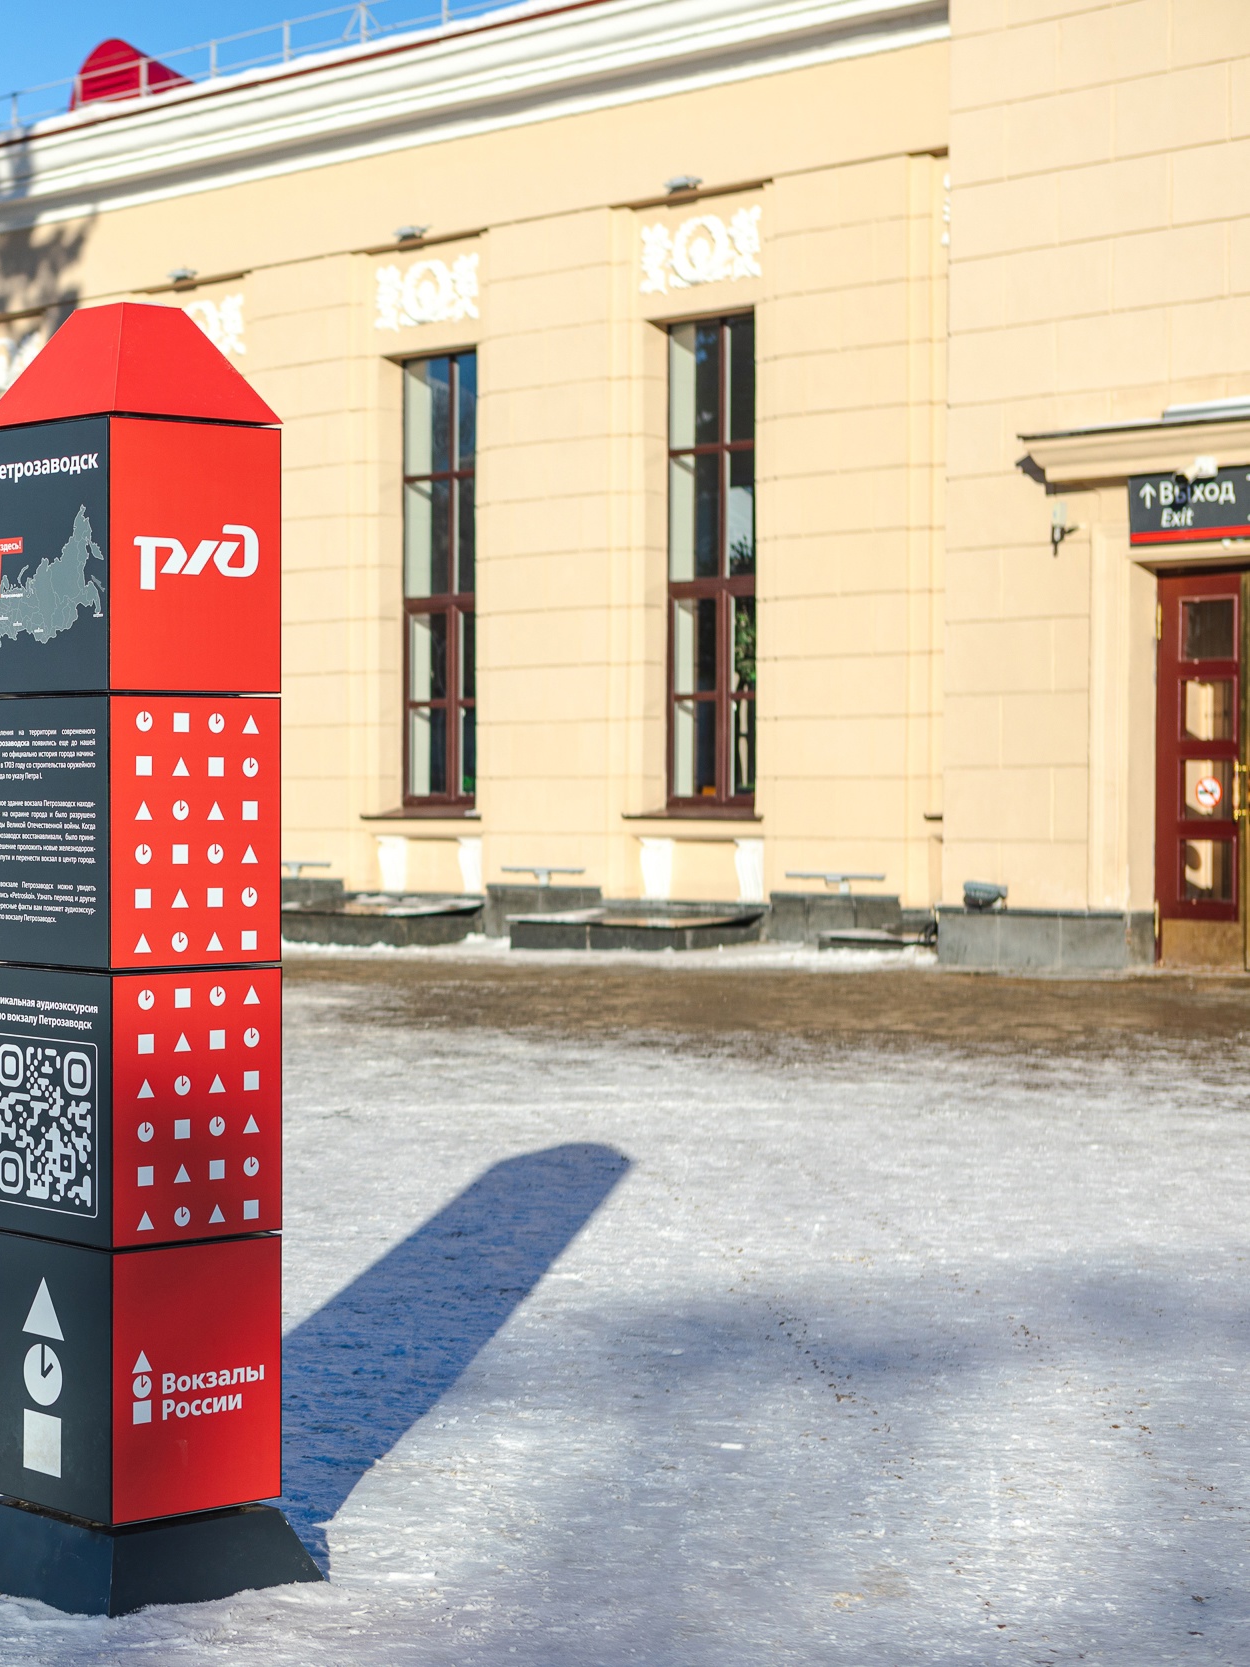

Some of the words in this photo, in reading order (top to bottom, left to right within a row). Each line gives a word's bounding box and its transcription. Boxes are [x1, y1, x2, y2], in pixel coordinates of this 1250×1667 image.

[1159, 480, 1236, 506] Выход
[1161, 507, 1194, 528] Exit
[0, 540, 22, 552] здесь!
[67, 761, 96, 769] оружейного
[25, 772, 39, 780] Петра
[44, 800, 76, 808] Петрозаводск
[70, 812, 96, 820] разрушено
[17, 844, 42, 852] проложить
[22, 882, 54, 890] Петрозаводск
[77, 884, 96, 892] увидеть
[54, 894, 74, 902] перевод
[79, 896, 96, 904] другие
[18, 903, 32, 911] факты
[6, 914, 23, 922] вокзалу
[24, 914, 57, 923] Петрозаводск.
[36, 1000, 98, 1015] аудиоэкскурсия
[7, 1013, 38, 1026] вокзалу
[38, 1015, 92, 1030] Петрозаводск
[162, 1364, 265, 1395] Вокзалы
[162, 1393, 242, 1421] России
